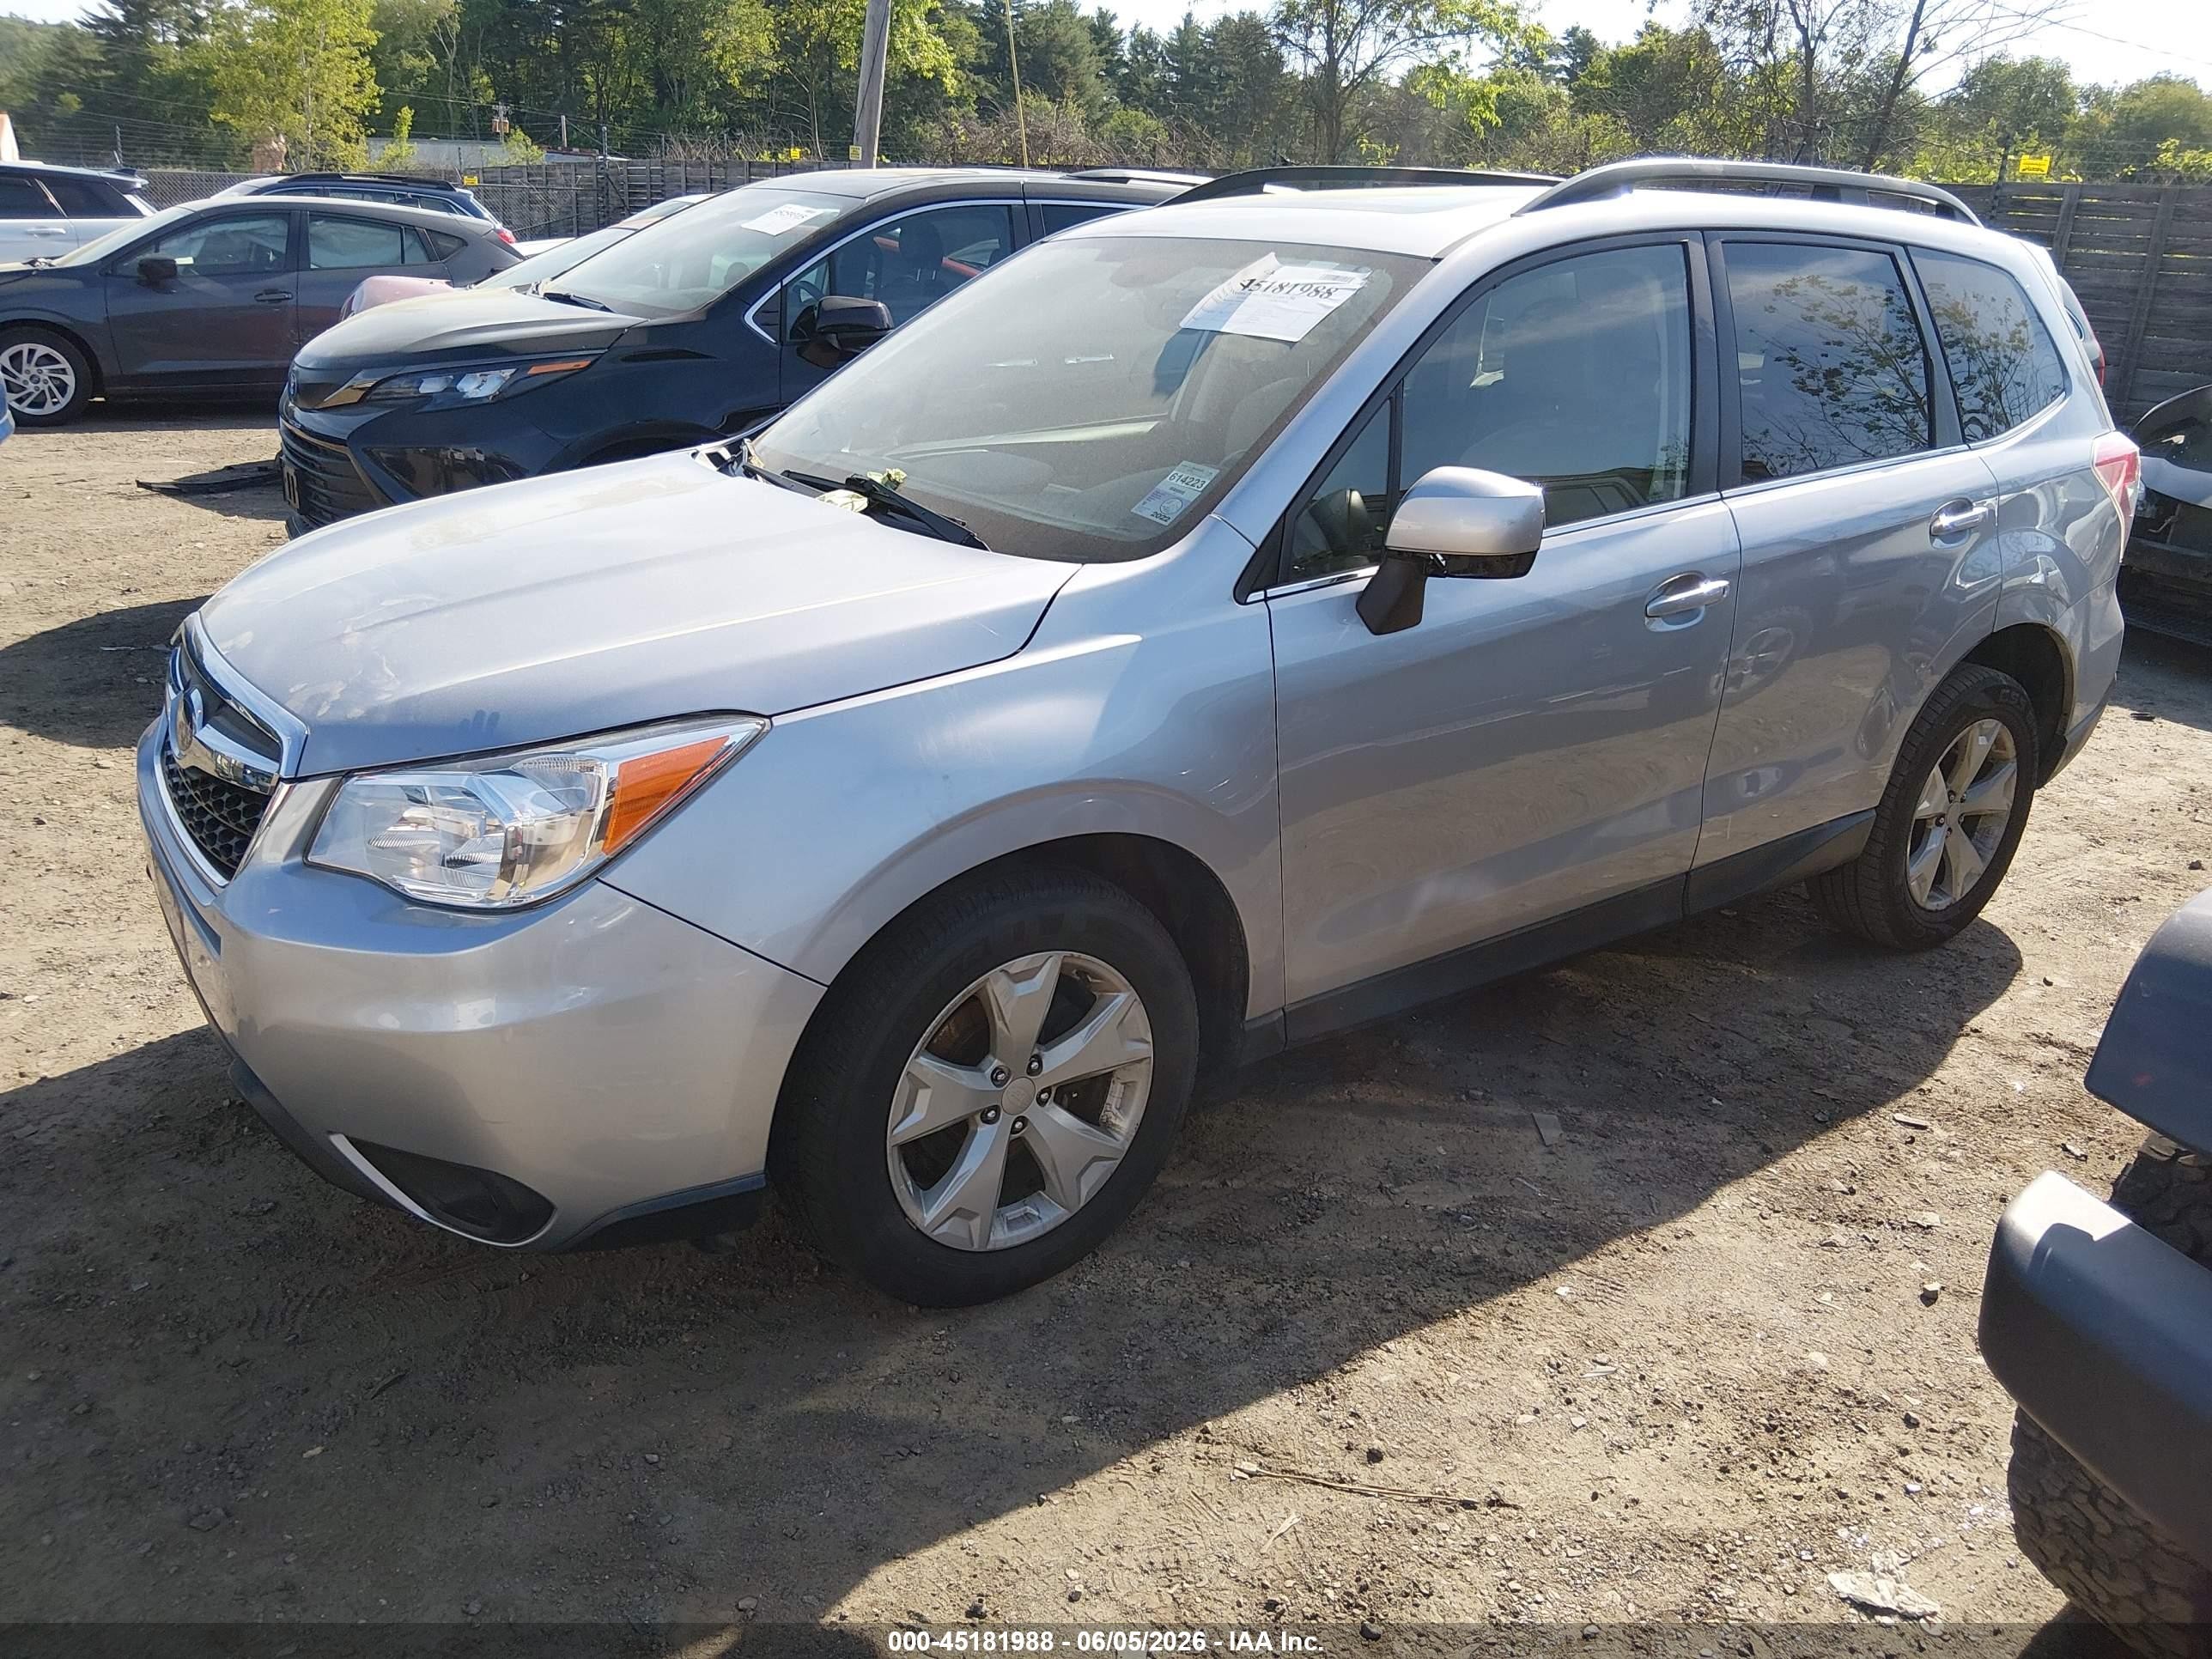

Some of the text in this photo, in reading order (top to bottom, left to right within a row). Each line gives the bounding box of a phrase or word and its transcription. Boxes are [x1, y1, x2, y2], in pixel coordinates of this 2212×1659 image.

[1239, 277, 1340, 299] 45181988
[1168, 472, 1206, 489] 614223
[1150, 511, 1171, 523] 2022
